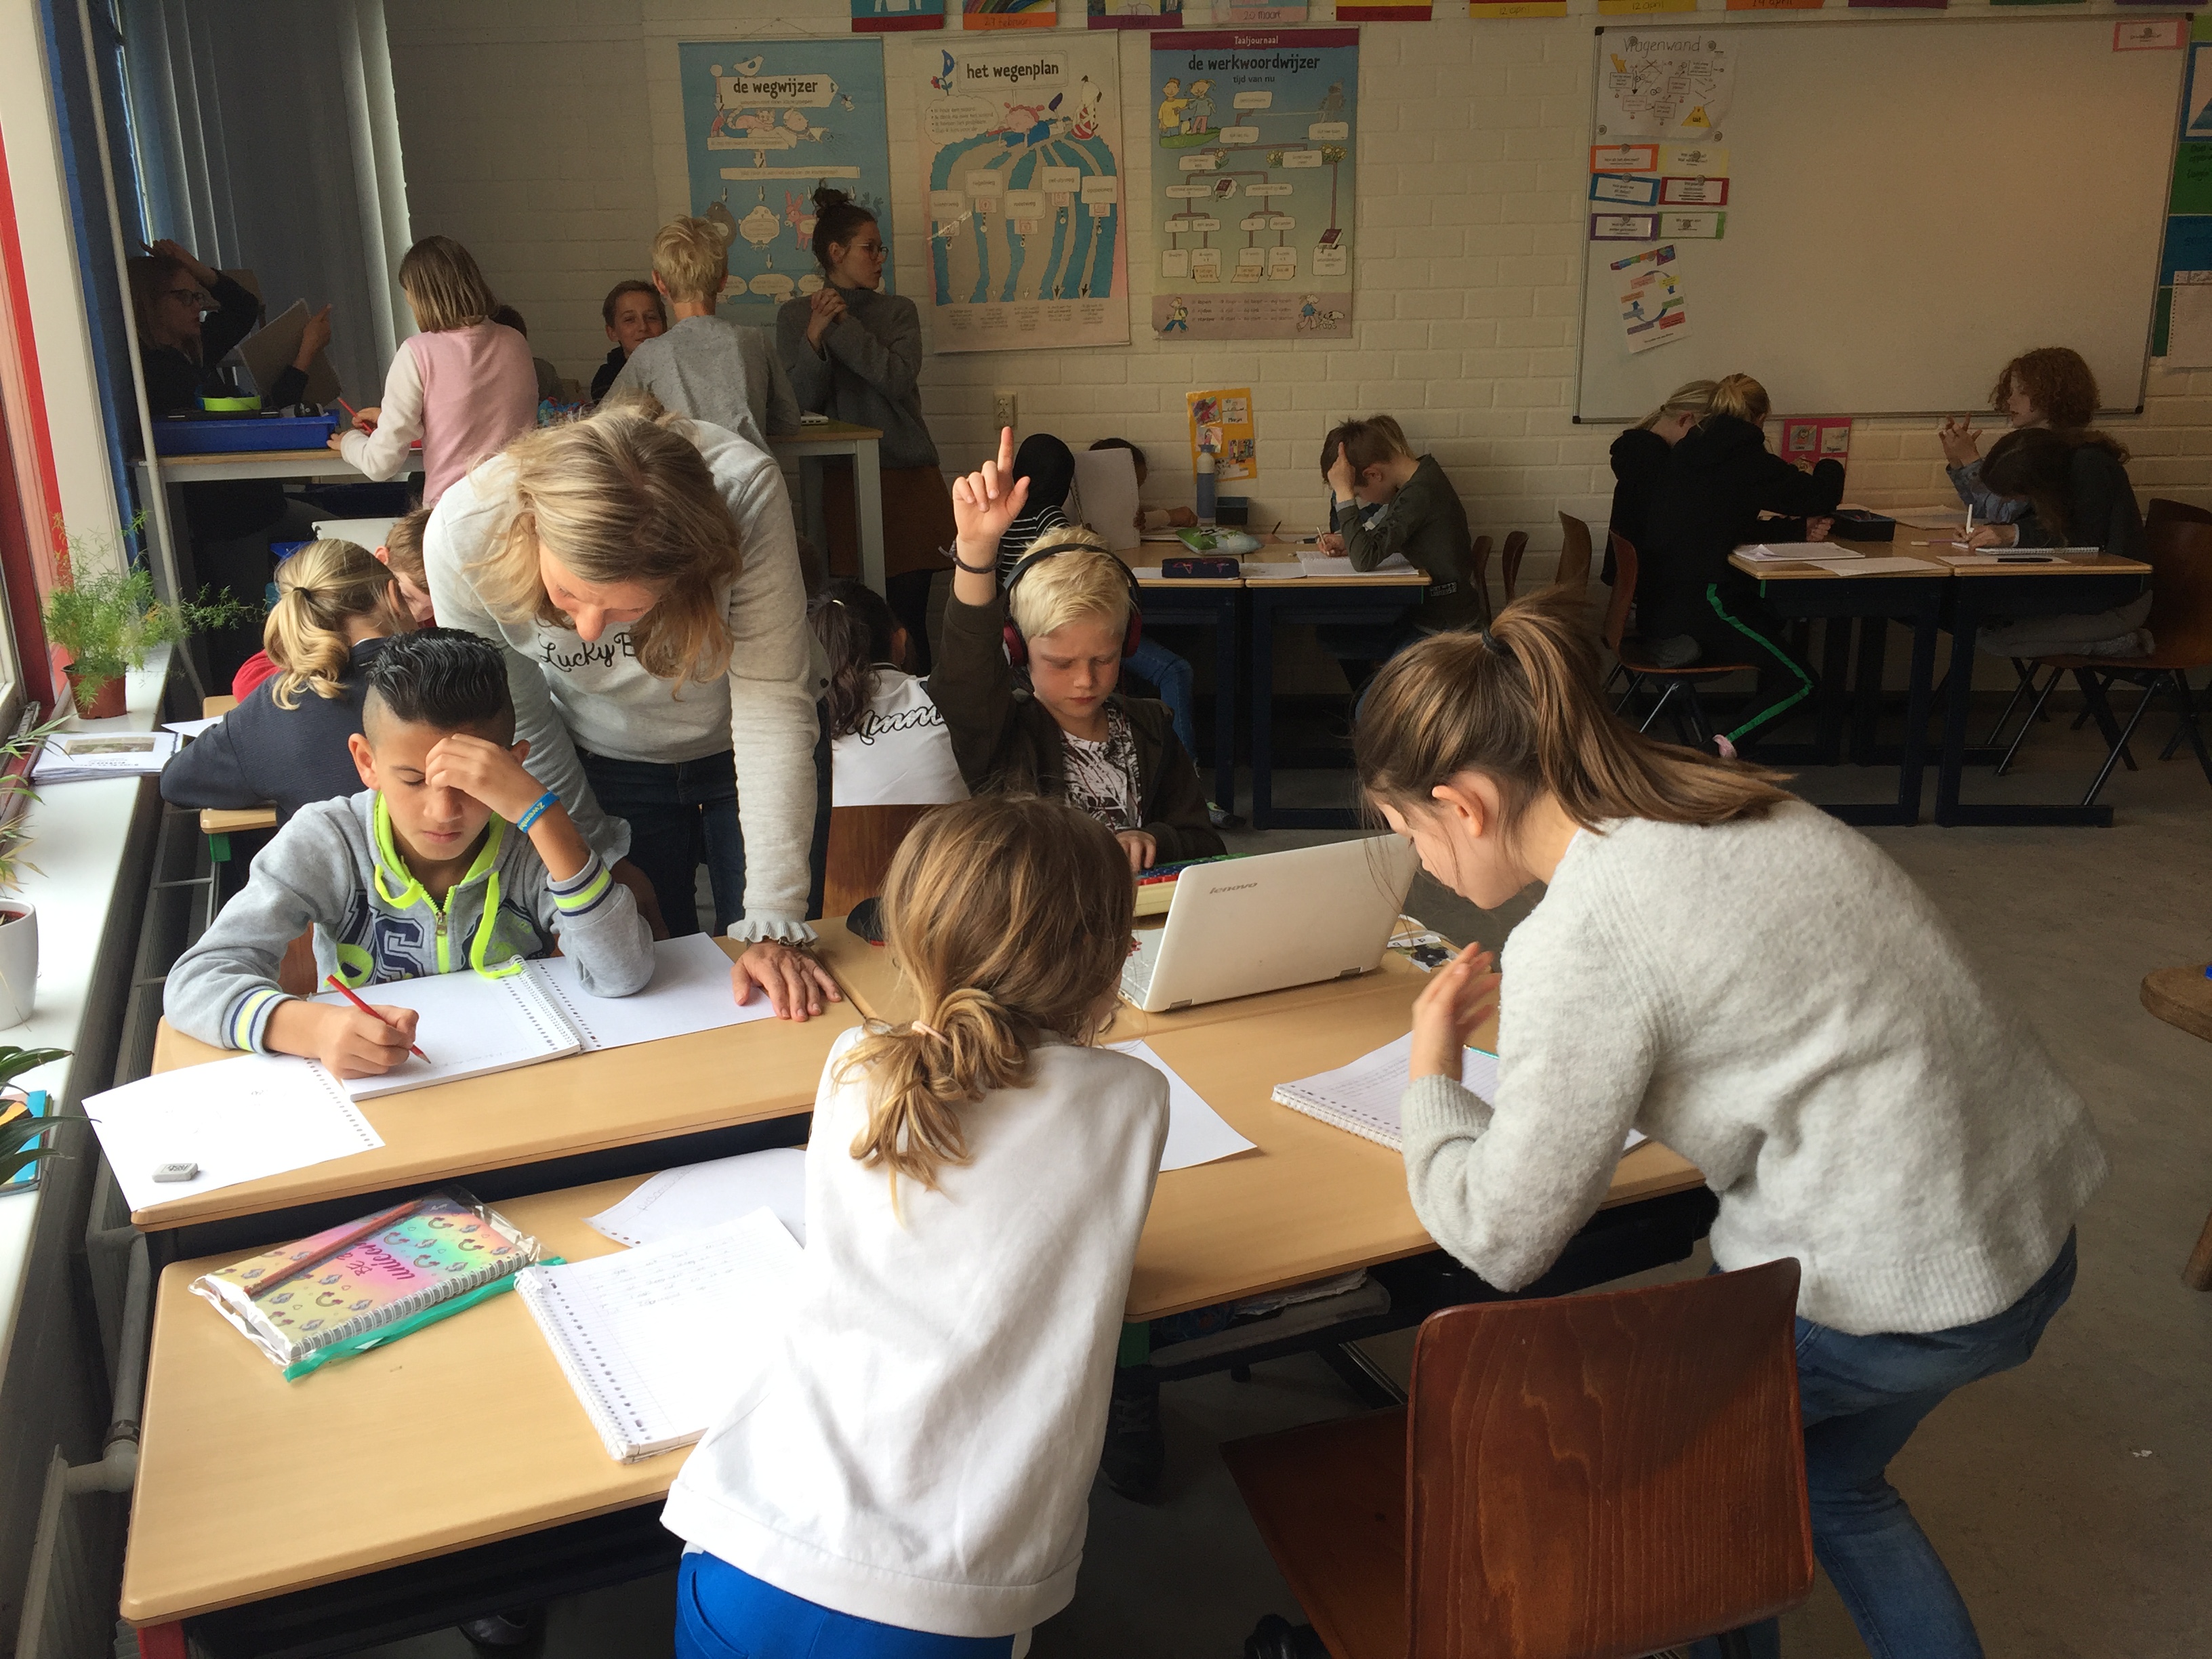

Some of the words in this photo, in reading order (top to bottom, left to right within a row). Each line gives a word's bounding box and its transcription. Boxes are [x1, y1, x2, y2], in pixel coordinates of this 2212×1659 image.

[1243, 11, 1256, 20] 20
[1234, 35, 1279, 46] Taaljournaal
[966, 63, 989, 79] het
[993, 59, 1059, 83] wegenplan
[1189, 54, 1204, 70] de
[1208, 53, 1321, 73] werkwoordwijzer
[733, 77, 748, 94] de
[753, 79, 818, 99] wegwijzer
[1233, 75, 1246, 85] tijd
[537, 632, 615, 672] Lucky
[1209, 882, 1258, 894] lenovo
[346, 1261, 373, 1277] BE
